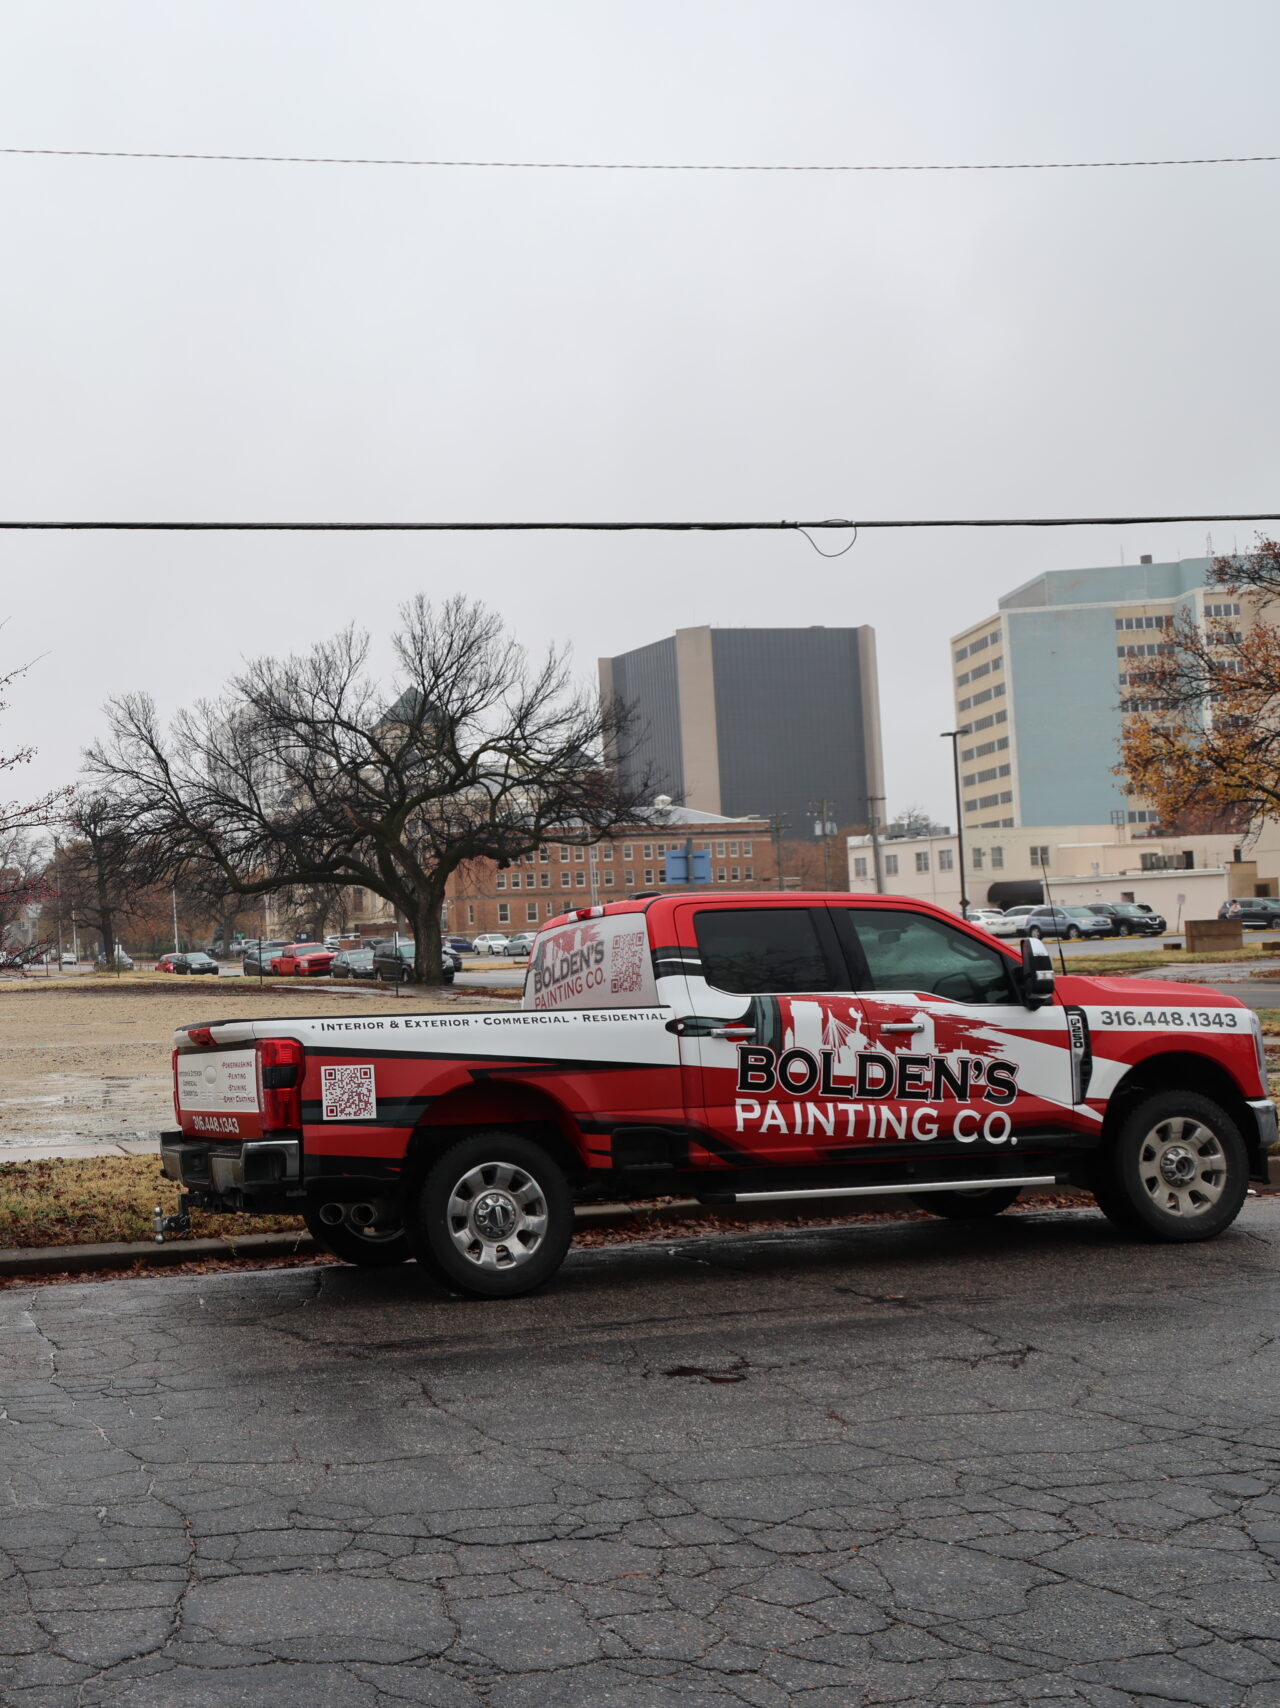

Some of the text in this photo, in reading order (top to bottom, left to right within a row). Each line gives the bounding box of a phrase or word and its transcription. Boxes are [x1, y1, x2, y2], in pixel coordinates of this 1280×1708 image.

[534, 941, 605, 995] BOLDEN'S
[534, 967, 606, 1009] PAINTING CO.
[321, 1012, 667, 1031] INTERIOR & EXTERIOR COMMERCIAL RESIDENTIAL
[1100, 1010, 1238, 1028] 316.448.1343
[736, 1044, 1020, 1105] BOLDEN'S
[192, 1115, 240, 1133] 316.448.1343
[734, 1098, 1018, 1145] PAINTING CO.
